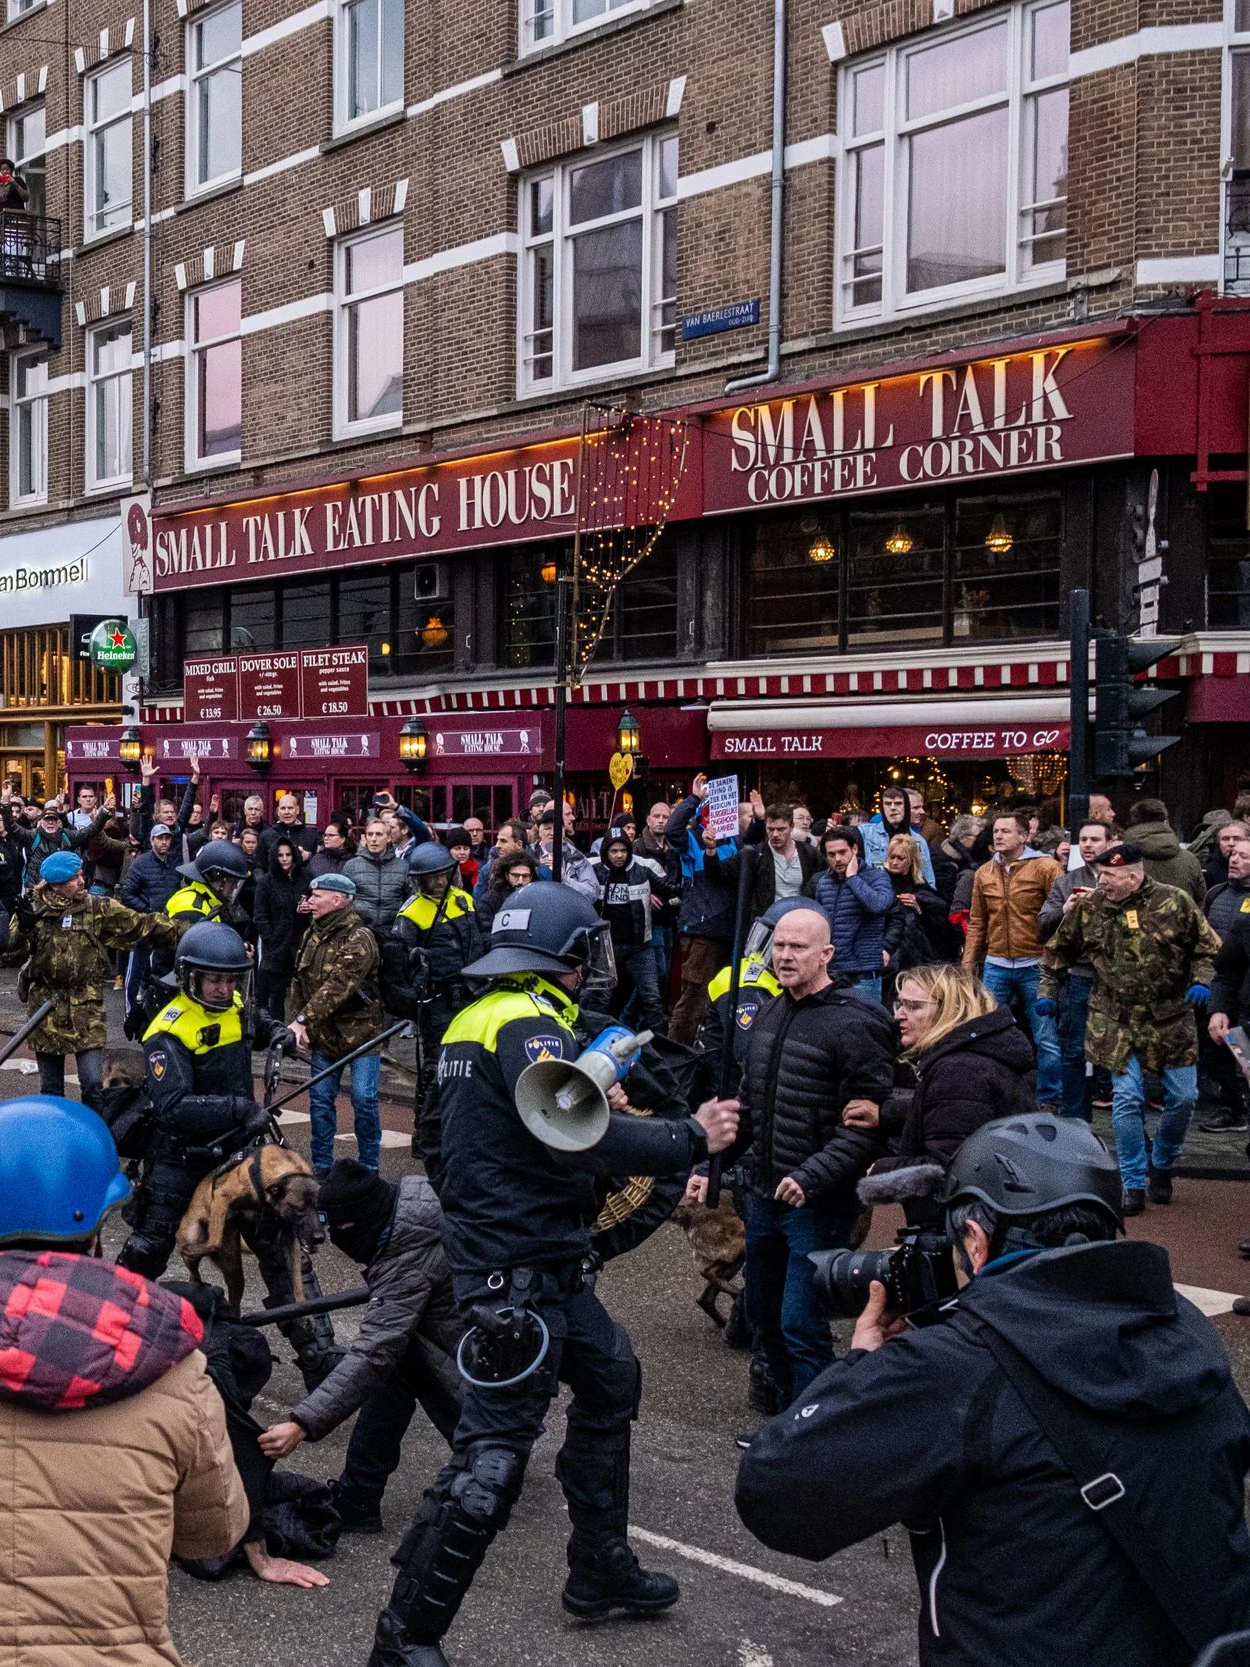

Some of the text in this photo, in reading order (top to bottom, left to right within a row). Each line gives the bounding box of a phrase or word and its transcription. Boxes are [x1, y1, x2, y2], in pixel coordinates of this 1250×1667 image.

[686, 303, 754, 327] VAN BAERLESTRAAT
[731, 349, 1075, 472] SMALL TALK
[748, 425, 1065, 503] COFFEE CORNER
[156, 459, 575, 577] SMALL TALK EATING HOUSE
[98, 651, 135, 660] Heineken
[303, 651, 365, 667] FILET STEAK
[185, 662, 236, 675] MIXED GRILL
[241, 657, 297, 671] DOVER SOLE
[206, 708, 221, 718] 13.95
[263, 705, 282, 716] 26.50
[328, 702, 348, 713] 18.50
[725, 730, 1060, 752] SMALL TALK COFFEE TO GO
[501, 913, 510, 927] C
